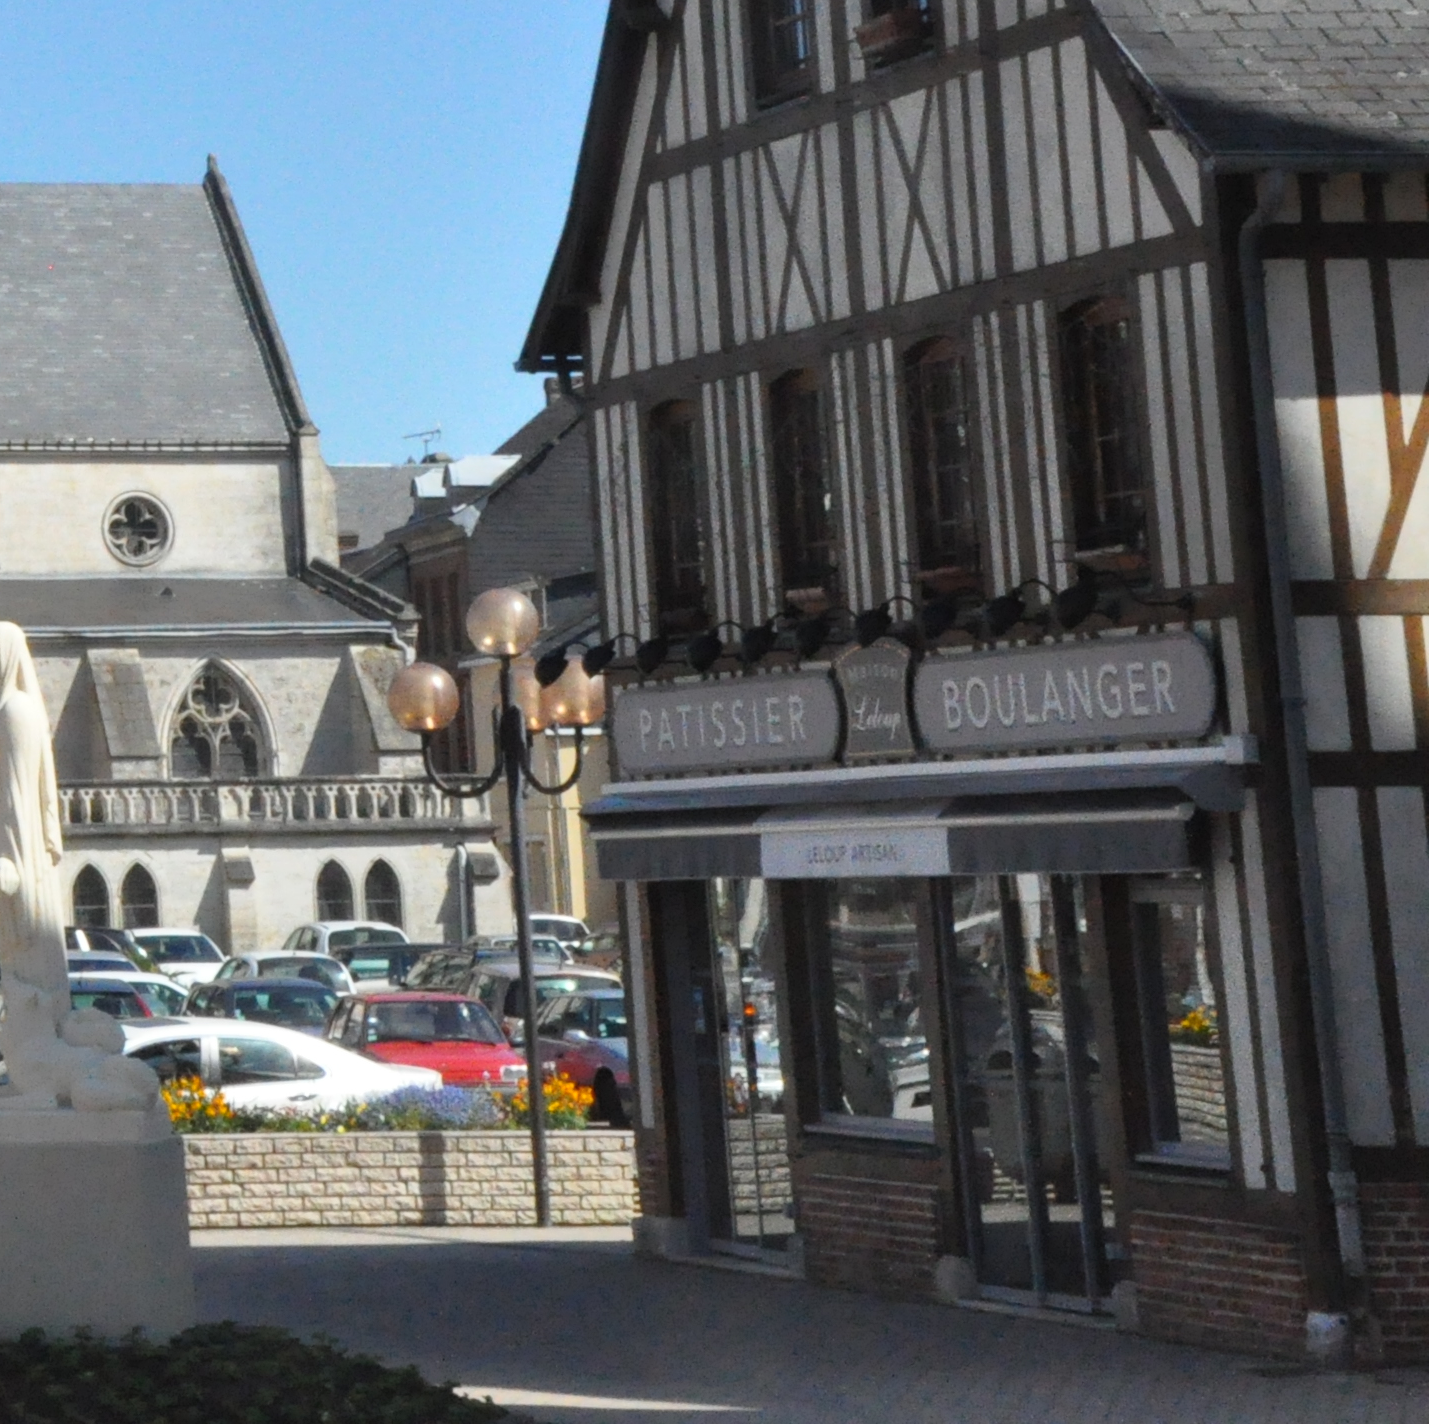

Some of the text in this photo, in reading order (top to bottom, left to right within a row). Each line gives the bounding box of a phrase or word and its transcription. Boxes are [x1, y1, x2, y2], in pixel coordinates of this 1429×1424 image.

[640, 694, 807, 753] PATISSIER
[941, 660, 1176, 731] BOULANGER
[808, 844, 847, 864] LELOUP
